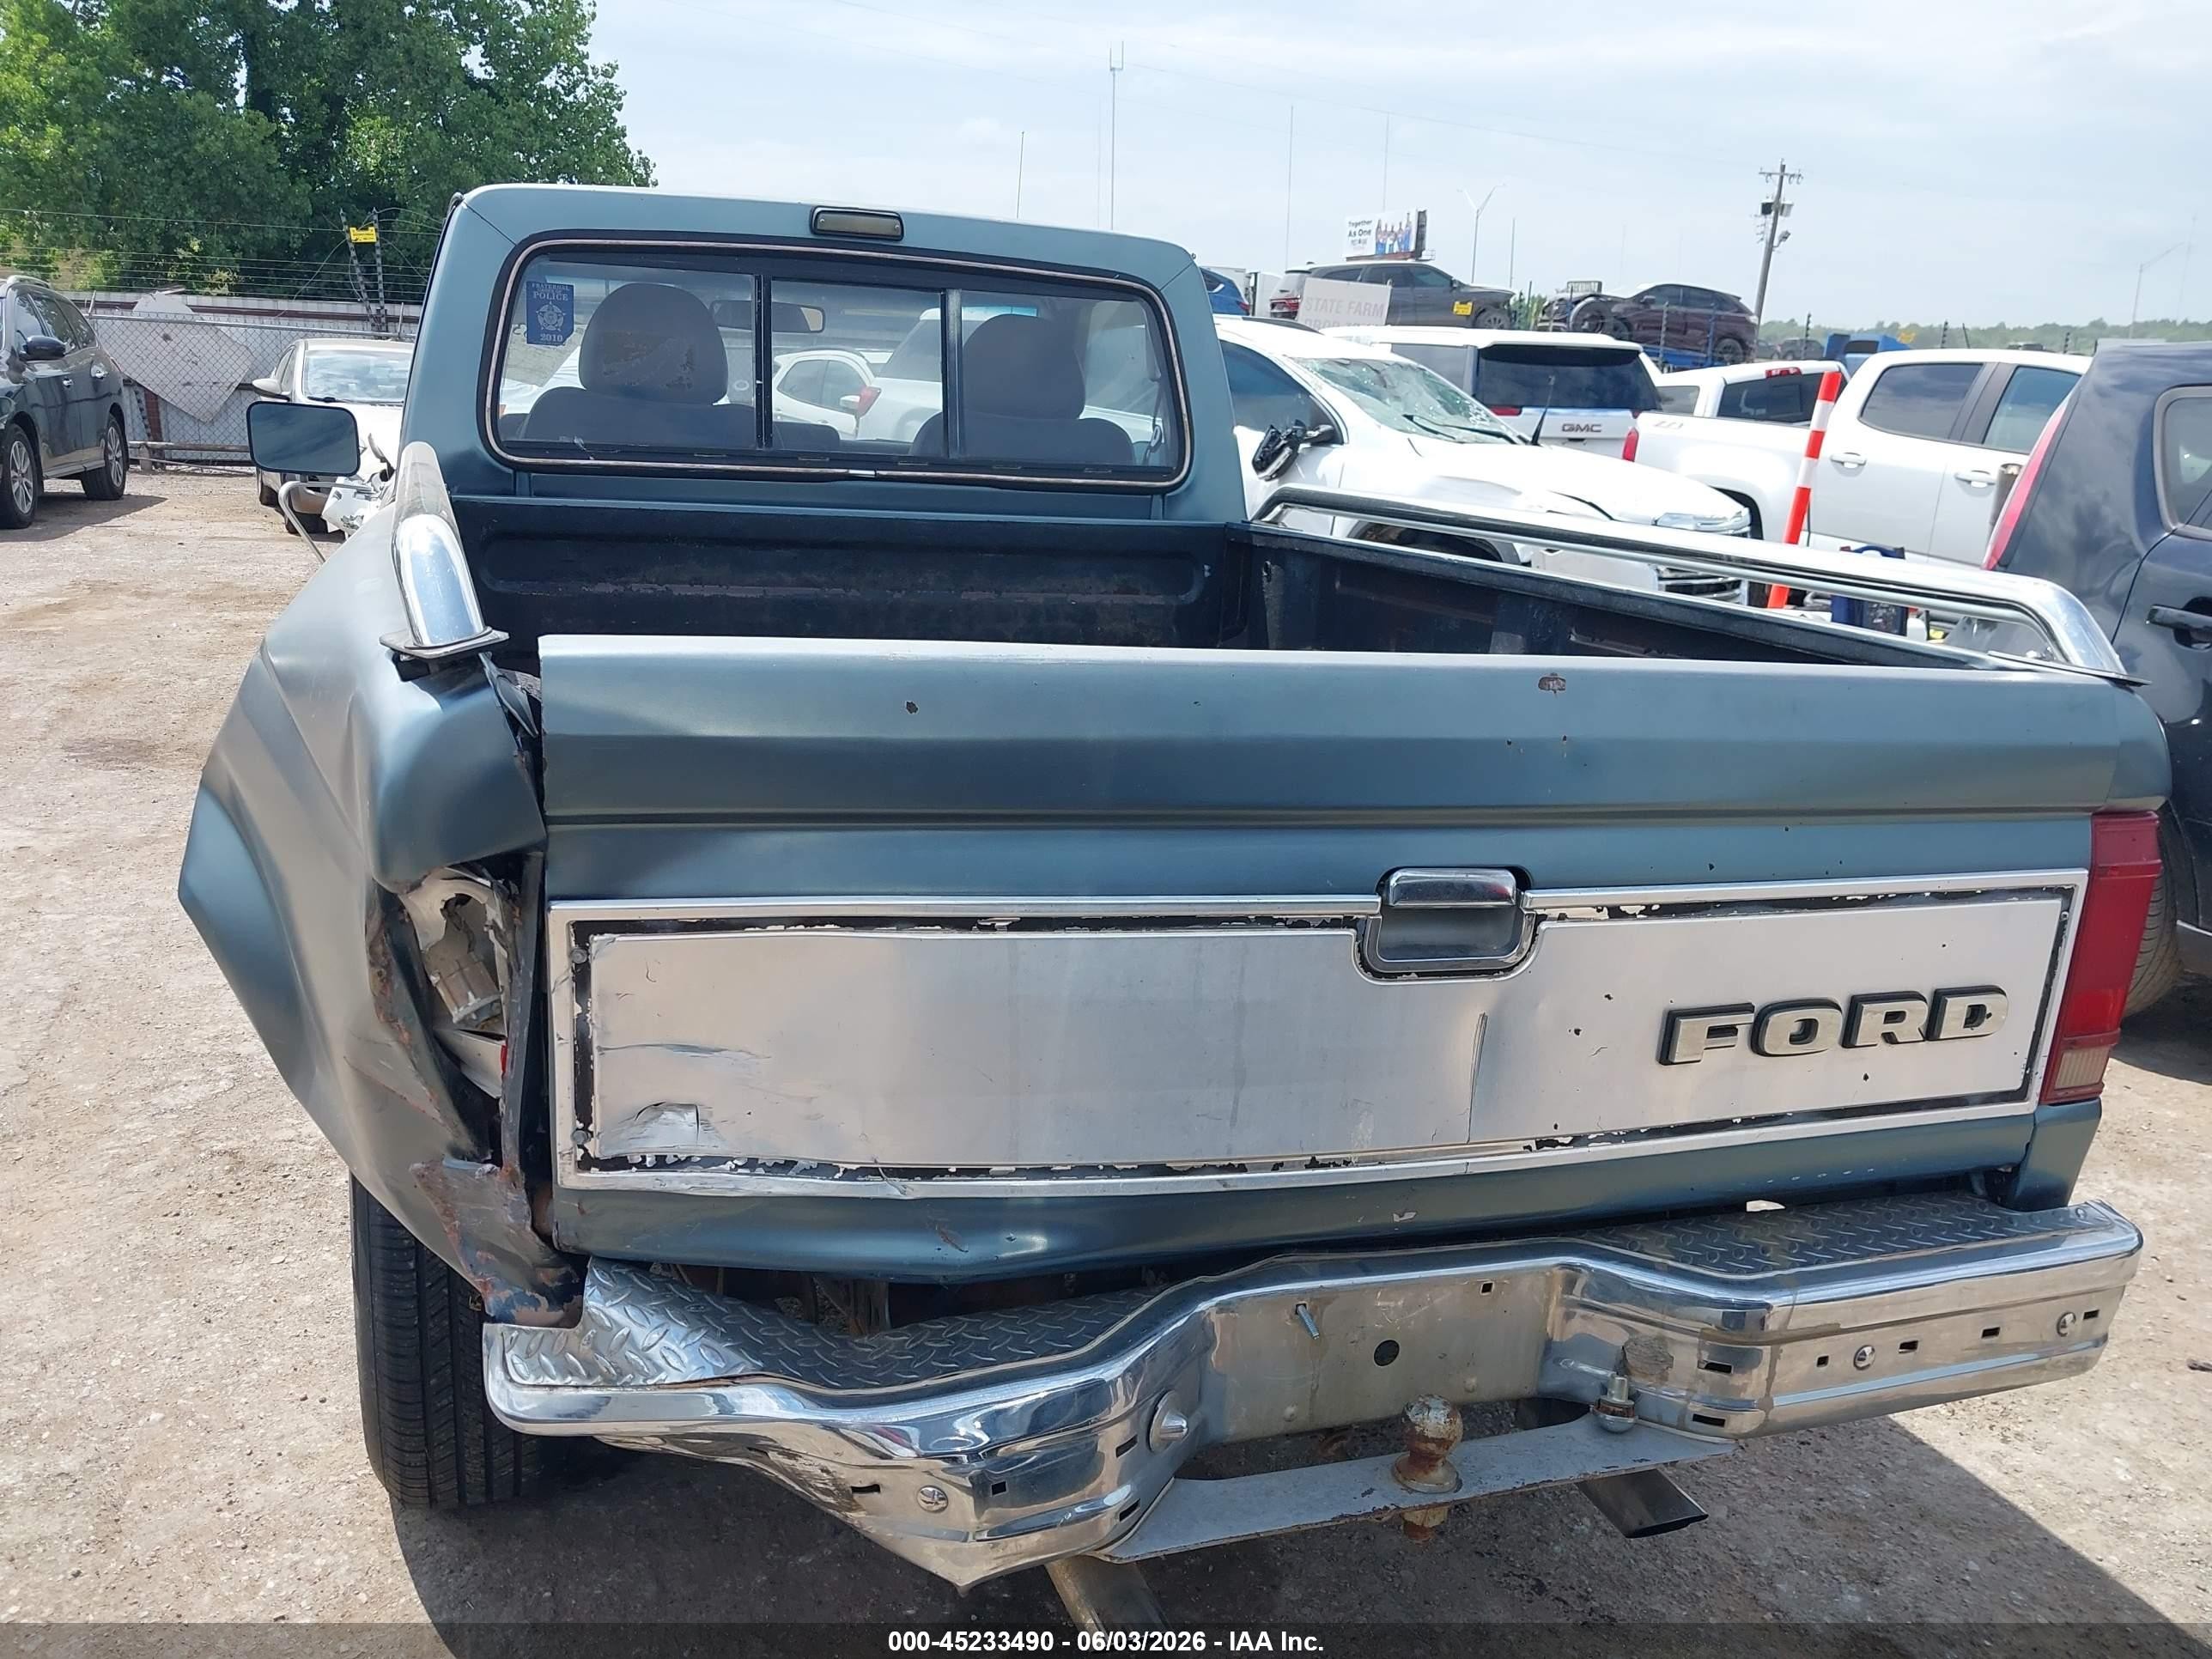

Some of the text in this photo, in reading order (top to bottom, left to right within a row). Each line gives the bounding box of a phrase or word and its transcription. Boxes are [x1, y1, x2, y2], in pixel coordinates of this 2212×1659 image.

[1358, 228, 1372, 237] One
[532, 291, 568, 301] POLICE
[1304, 297, 1385, 318] STATE FARM
[539, 333, 563, 343] 2010
[1561, 423, 1602, 433] GMC
[1656, 984, 2008, 1066] FORD
